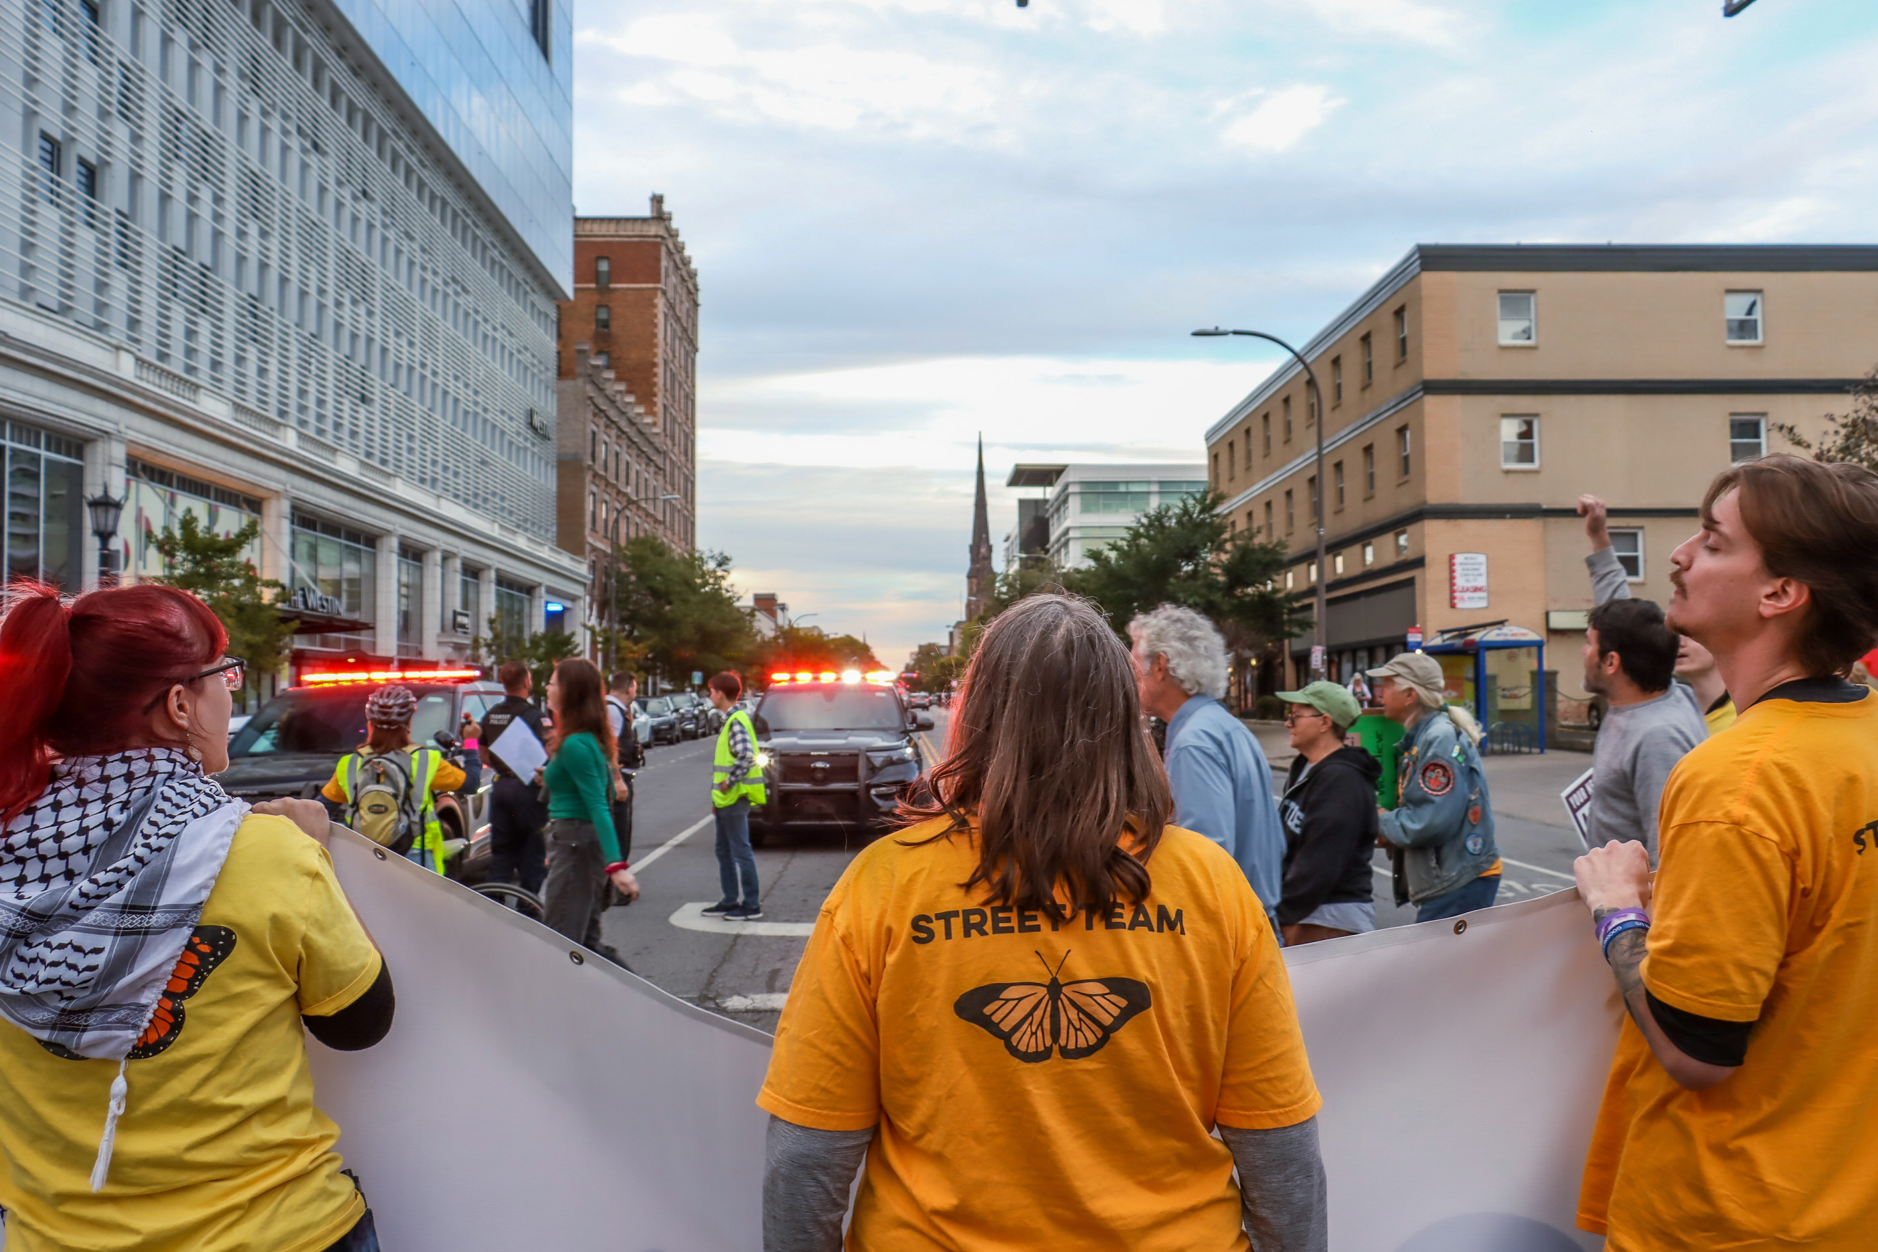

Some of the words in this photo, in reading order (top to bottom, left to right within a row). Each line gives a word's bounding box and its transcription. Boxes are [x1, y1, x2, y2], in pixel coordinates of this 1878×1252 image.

[304, 587, 343, 615] WESTIN
[911, 903, 1067, 945] STREET
[1079, 902, 1185, 936] TEAM
